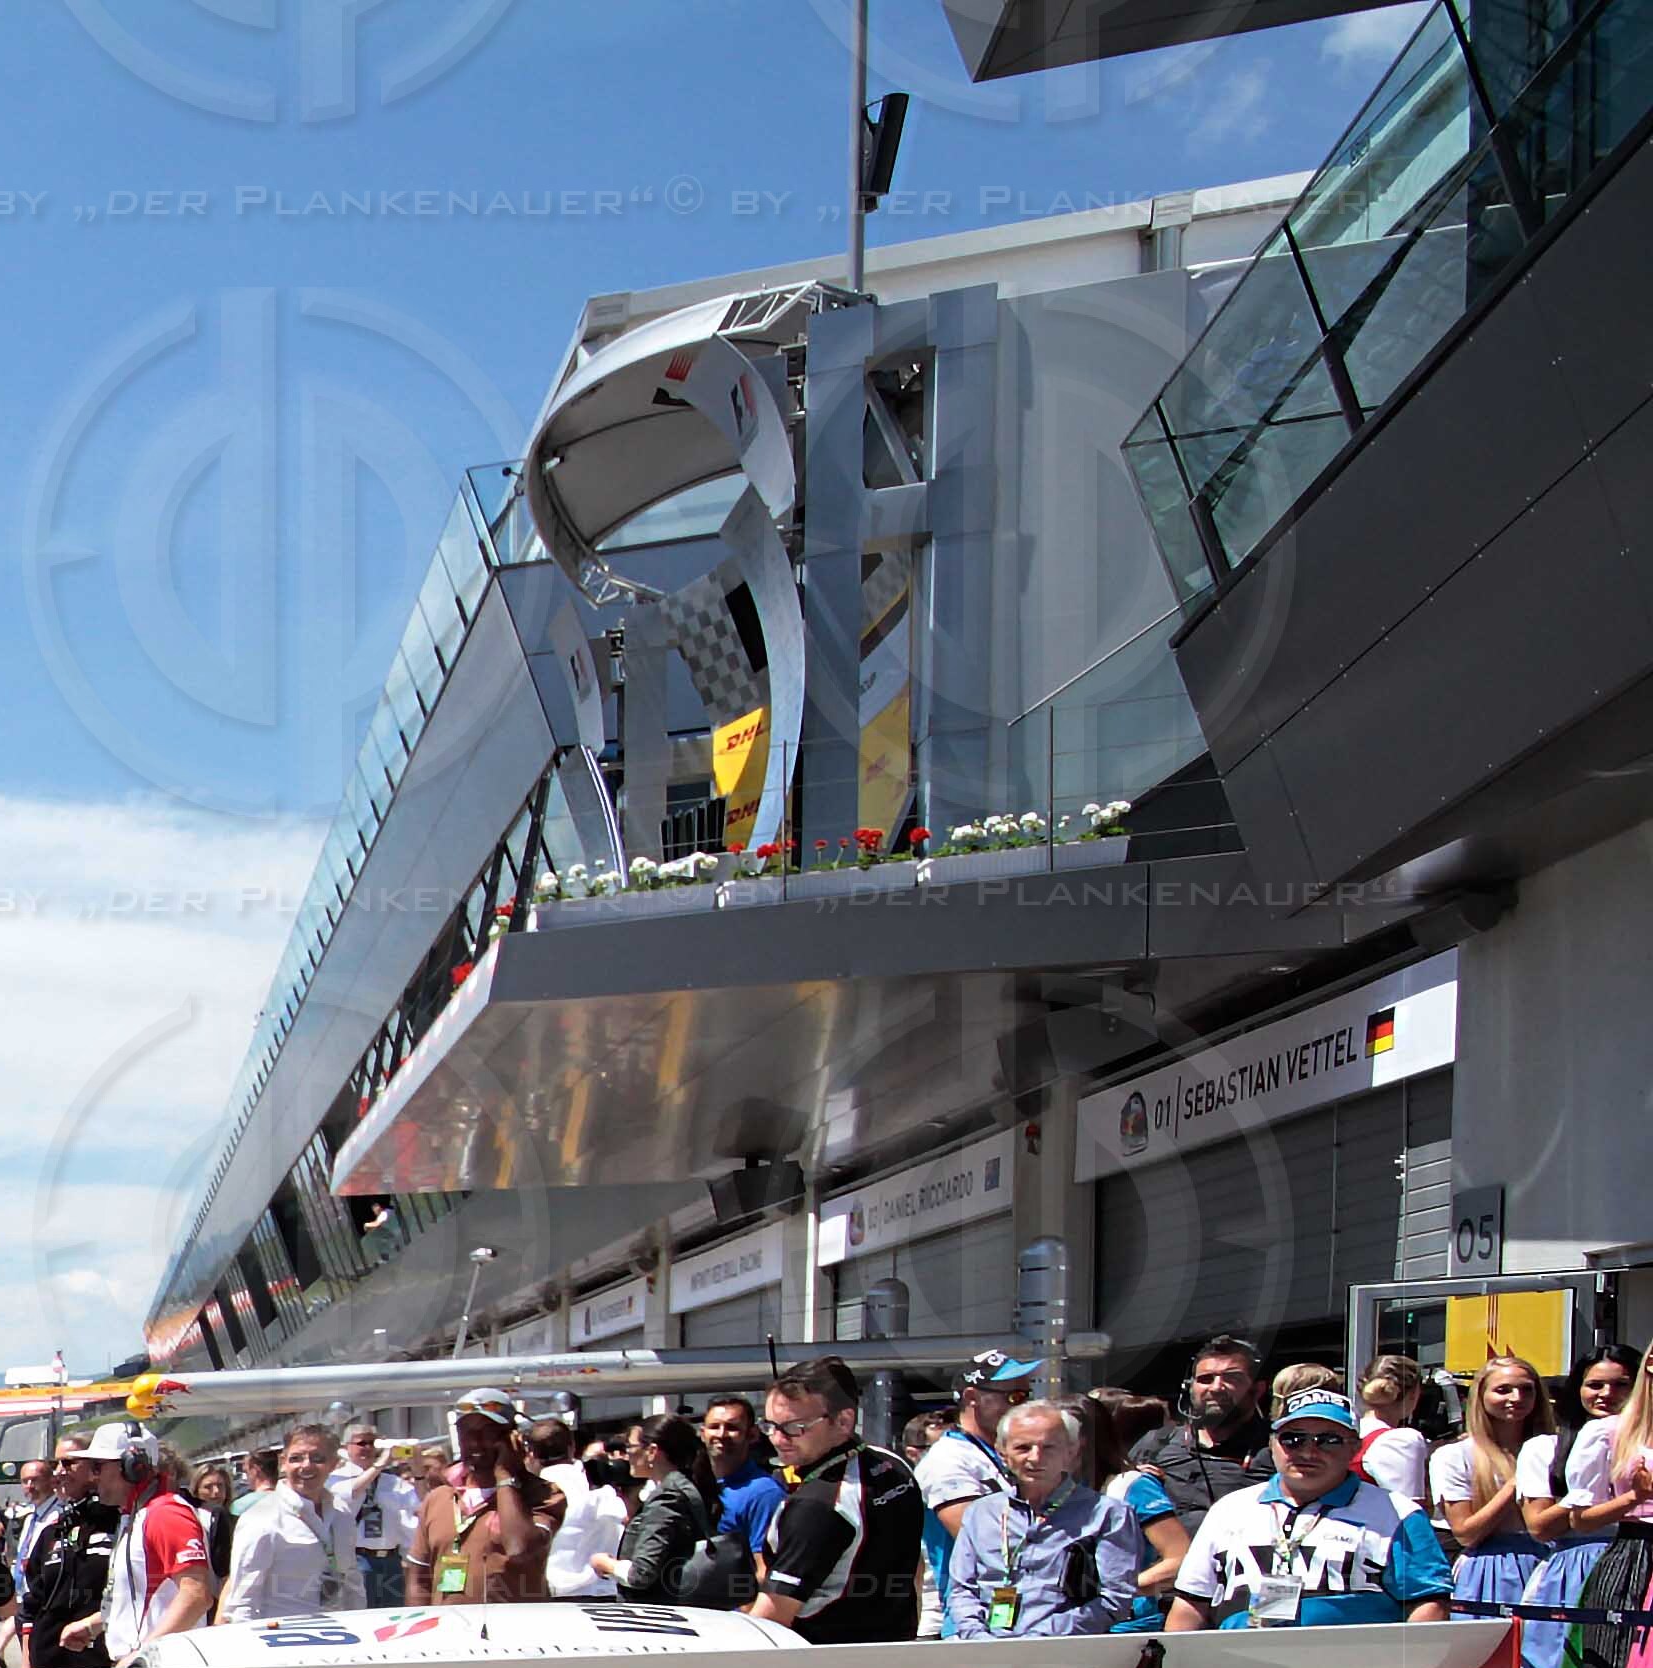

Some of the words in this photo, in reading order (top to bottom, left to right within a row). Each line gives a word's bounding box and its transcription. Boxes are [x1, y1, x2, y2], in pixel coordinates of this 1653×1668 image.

[1154, 1094, 1173, 1132] 01
[1183, 1054, 1281, 1121] SEBASTIAN
[1287, 1026, 1358, 1081] VETTEL
[1455, 1214, 1494, 1263] 05
